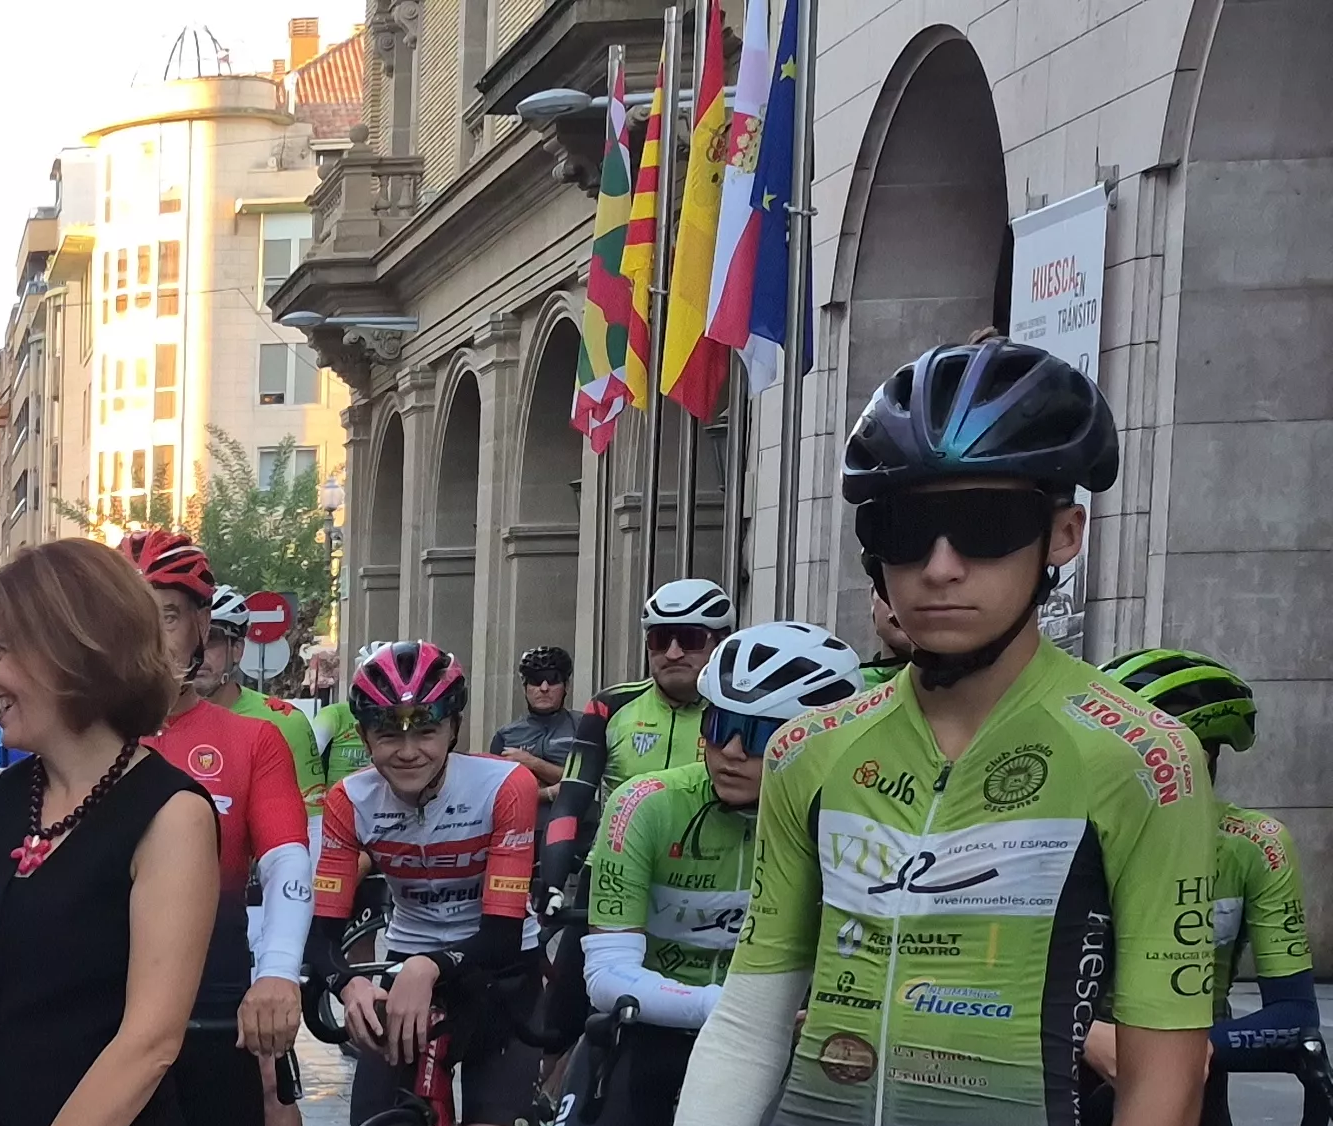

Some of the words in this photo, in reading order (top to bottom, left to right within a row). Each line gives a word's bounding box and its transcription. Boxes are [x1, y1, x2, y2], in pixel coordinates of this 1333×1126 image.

[1031, 255, 1077, 303] HUESCA
[1074, 271, 1087, 297] EN
[1058, 299, 1097, 334] TRÁNSITO
[1002, 841, 1015, 850] TU
[1020, 840, 1069, 850] ESPACIO
[934, 895, 1053, 906] viveinmuebles.com
[868, 932, 962, 946] RENAULT
[897, 945, 961, 957] CUATRO
[914, 994, 1014, 1019] Huesca
